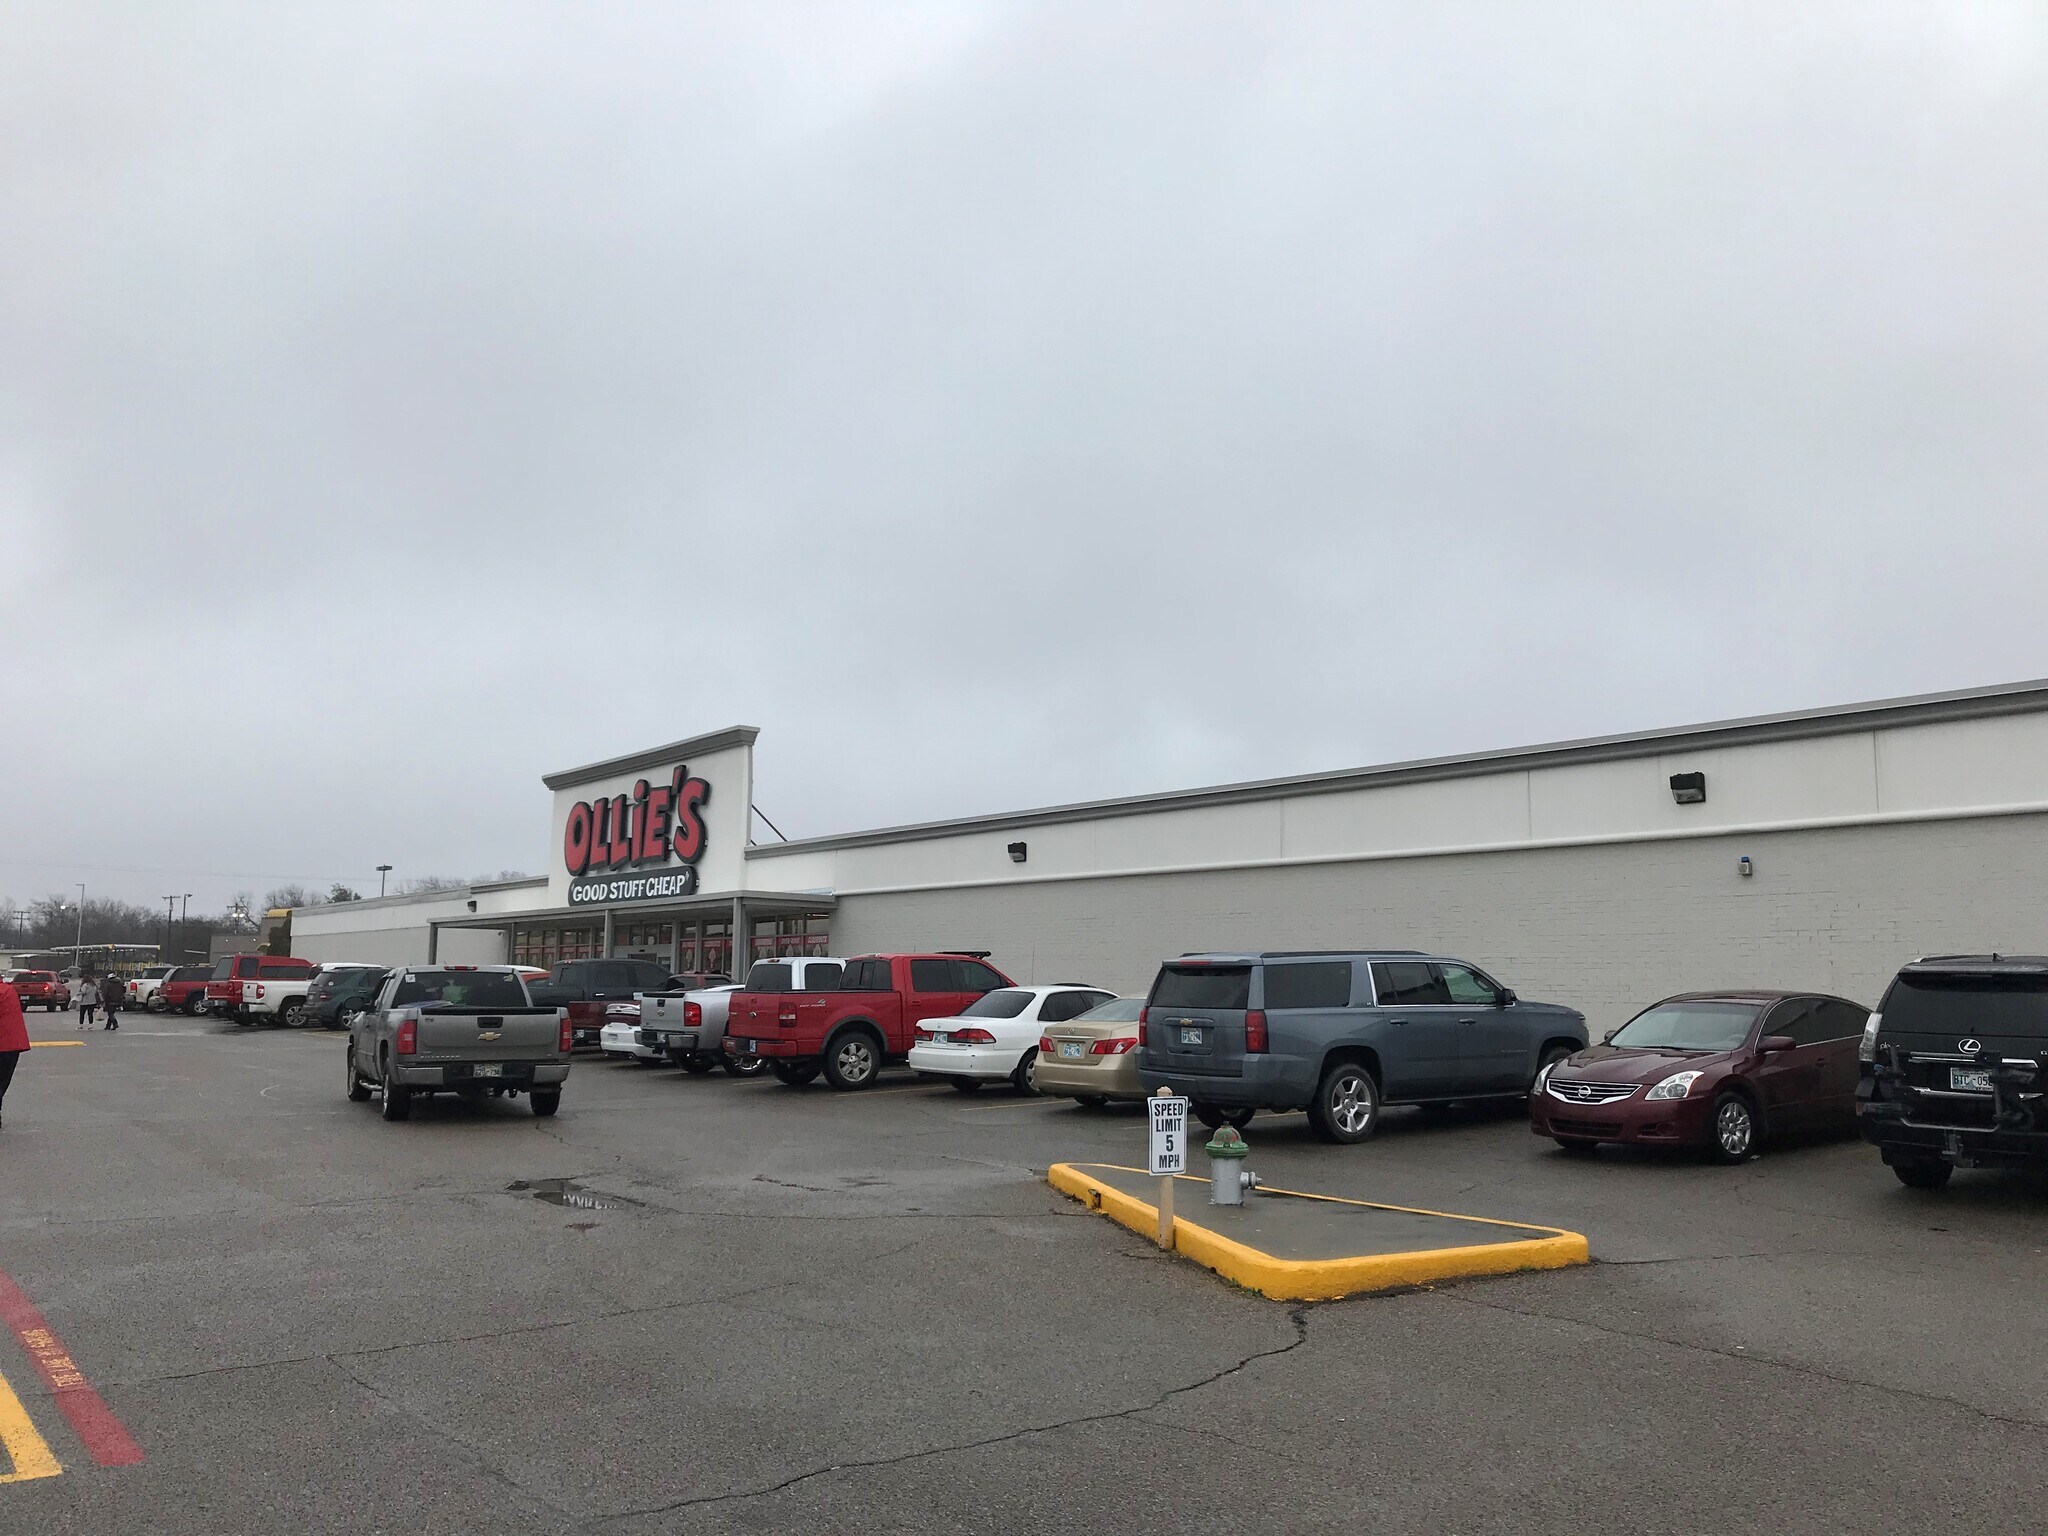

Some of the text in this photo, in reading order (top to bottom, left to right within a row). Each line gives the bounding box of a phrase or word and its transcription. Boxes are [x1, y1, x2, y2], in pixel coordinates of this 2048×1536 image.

[609, 879, 646, 899] STUFF
[1154, 1103, 1183, 1116] SPEED
[1155, 1118, 1182, 1132] LIMIT
[1165, 1134, 1174, 1152] 5
[1158, 1154, 1180, 1169] MPH
